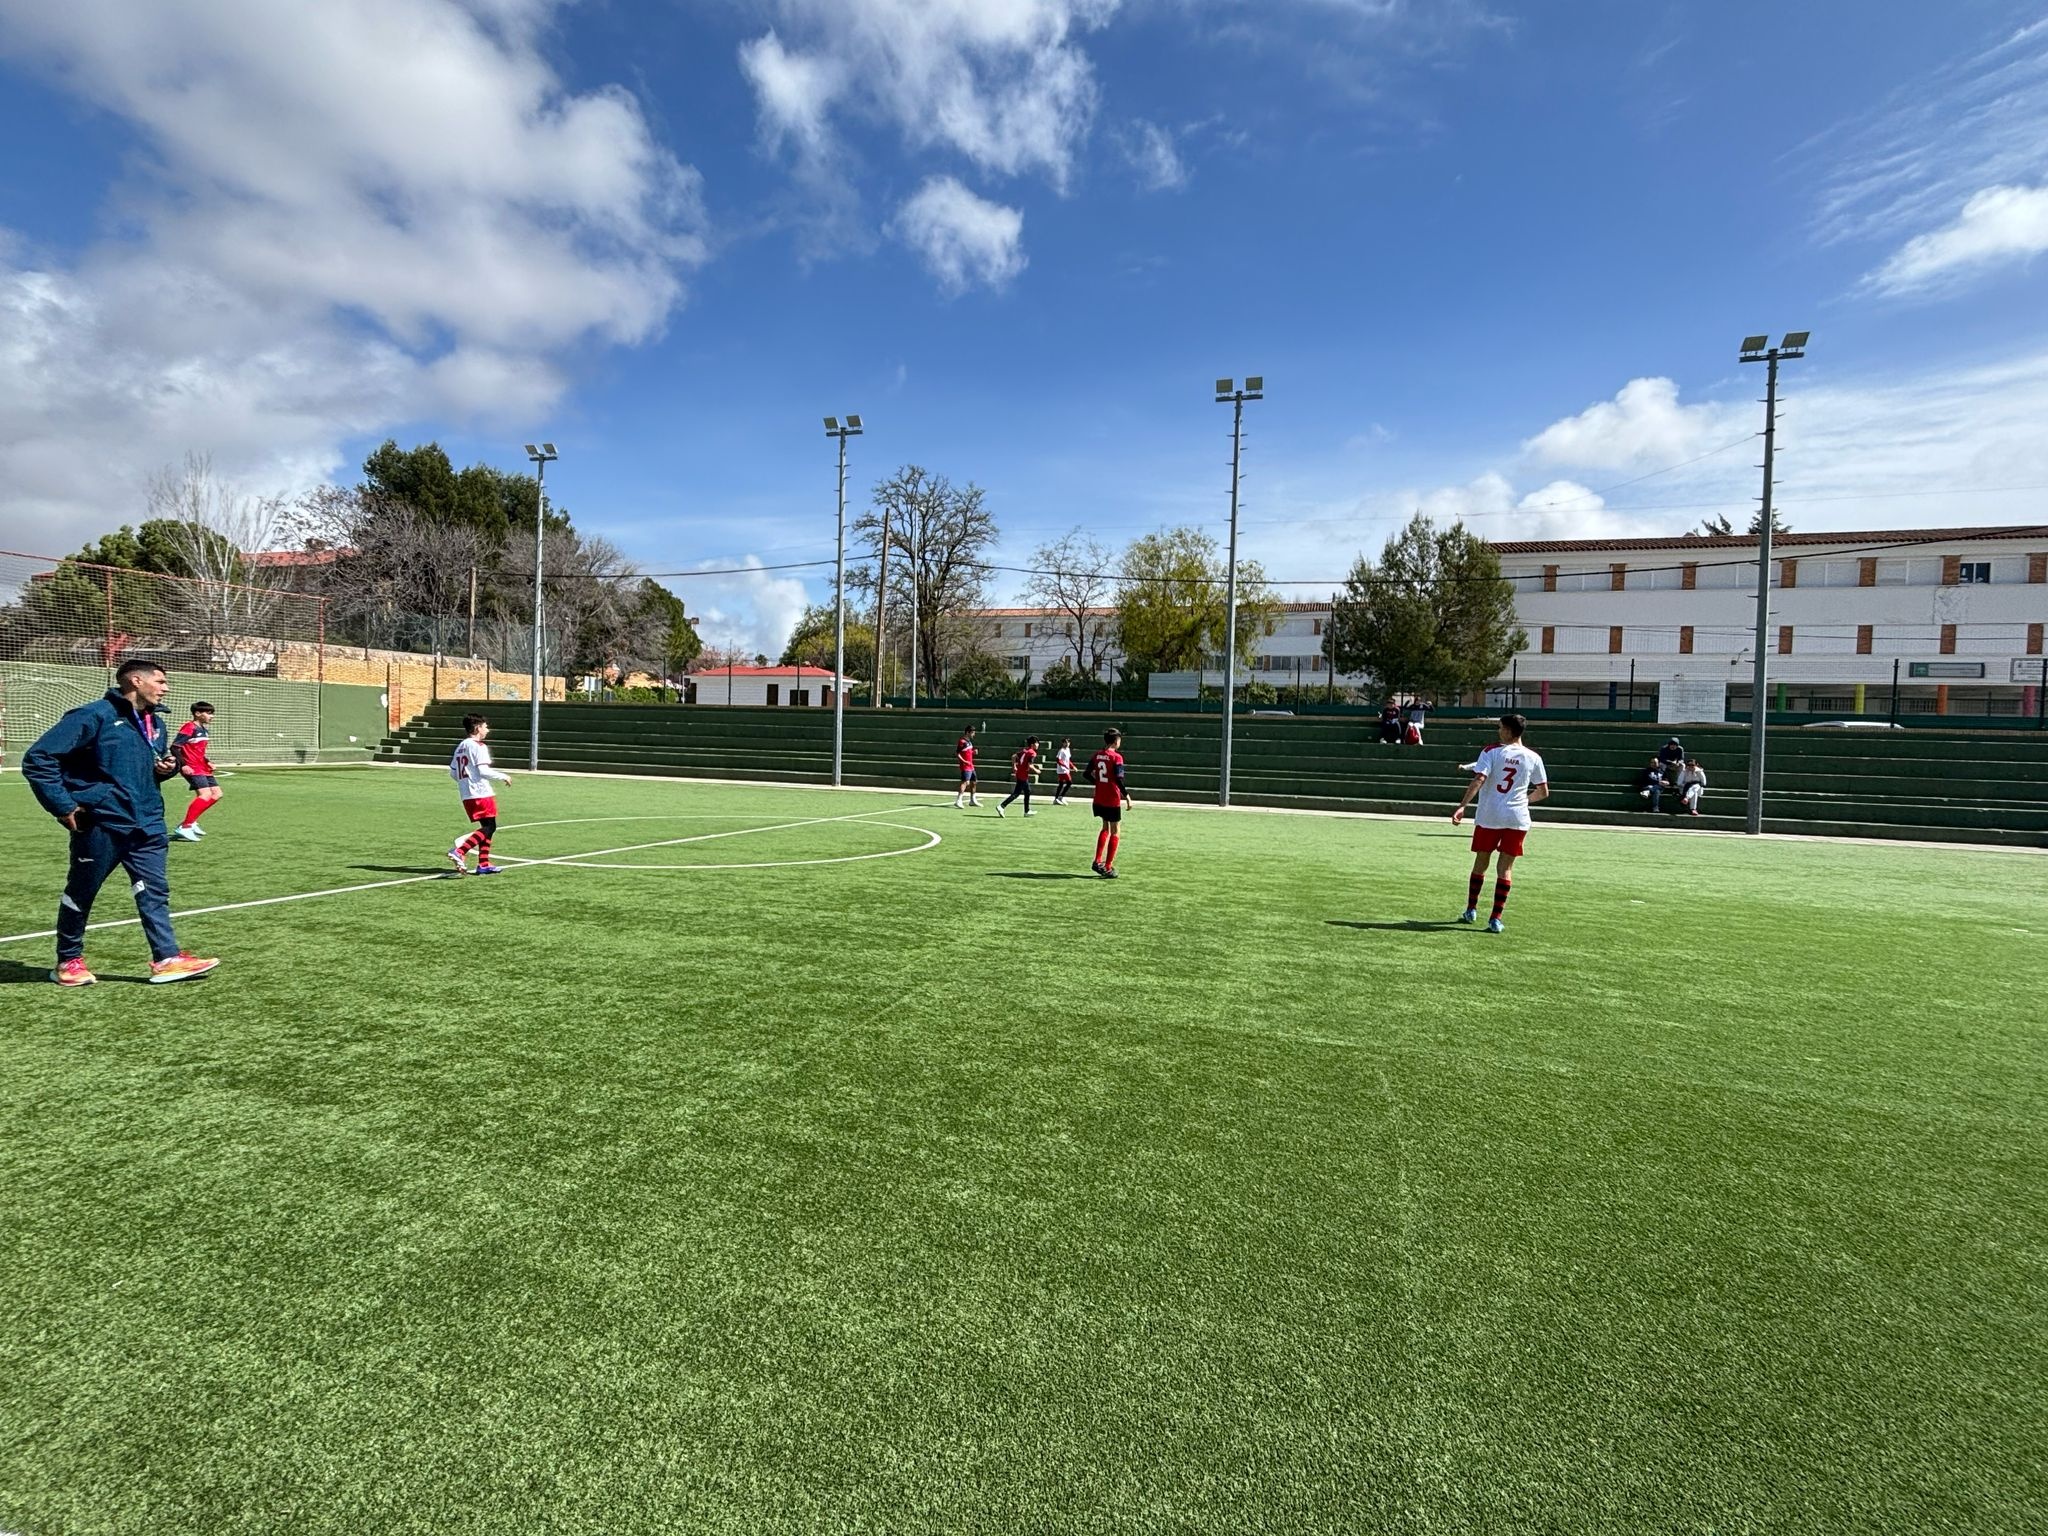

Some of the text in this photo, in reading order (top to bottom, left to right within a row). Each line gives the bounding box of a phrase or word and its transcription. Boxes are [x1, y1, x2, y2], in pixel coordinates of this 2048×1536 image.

[456, 756, 469, 779] 12
[1097, 761, 1109, 783] 2
[1497, 767, 1517, 793] 3
